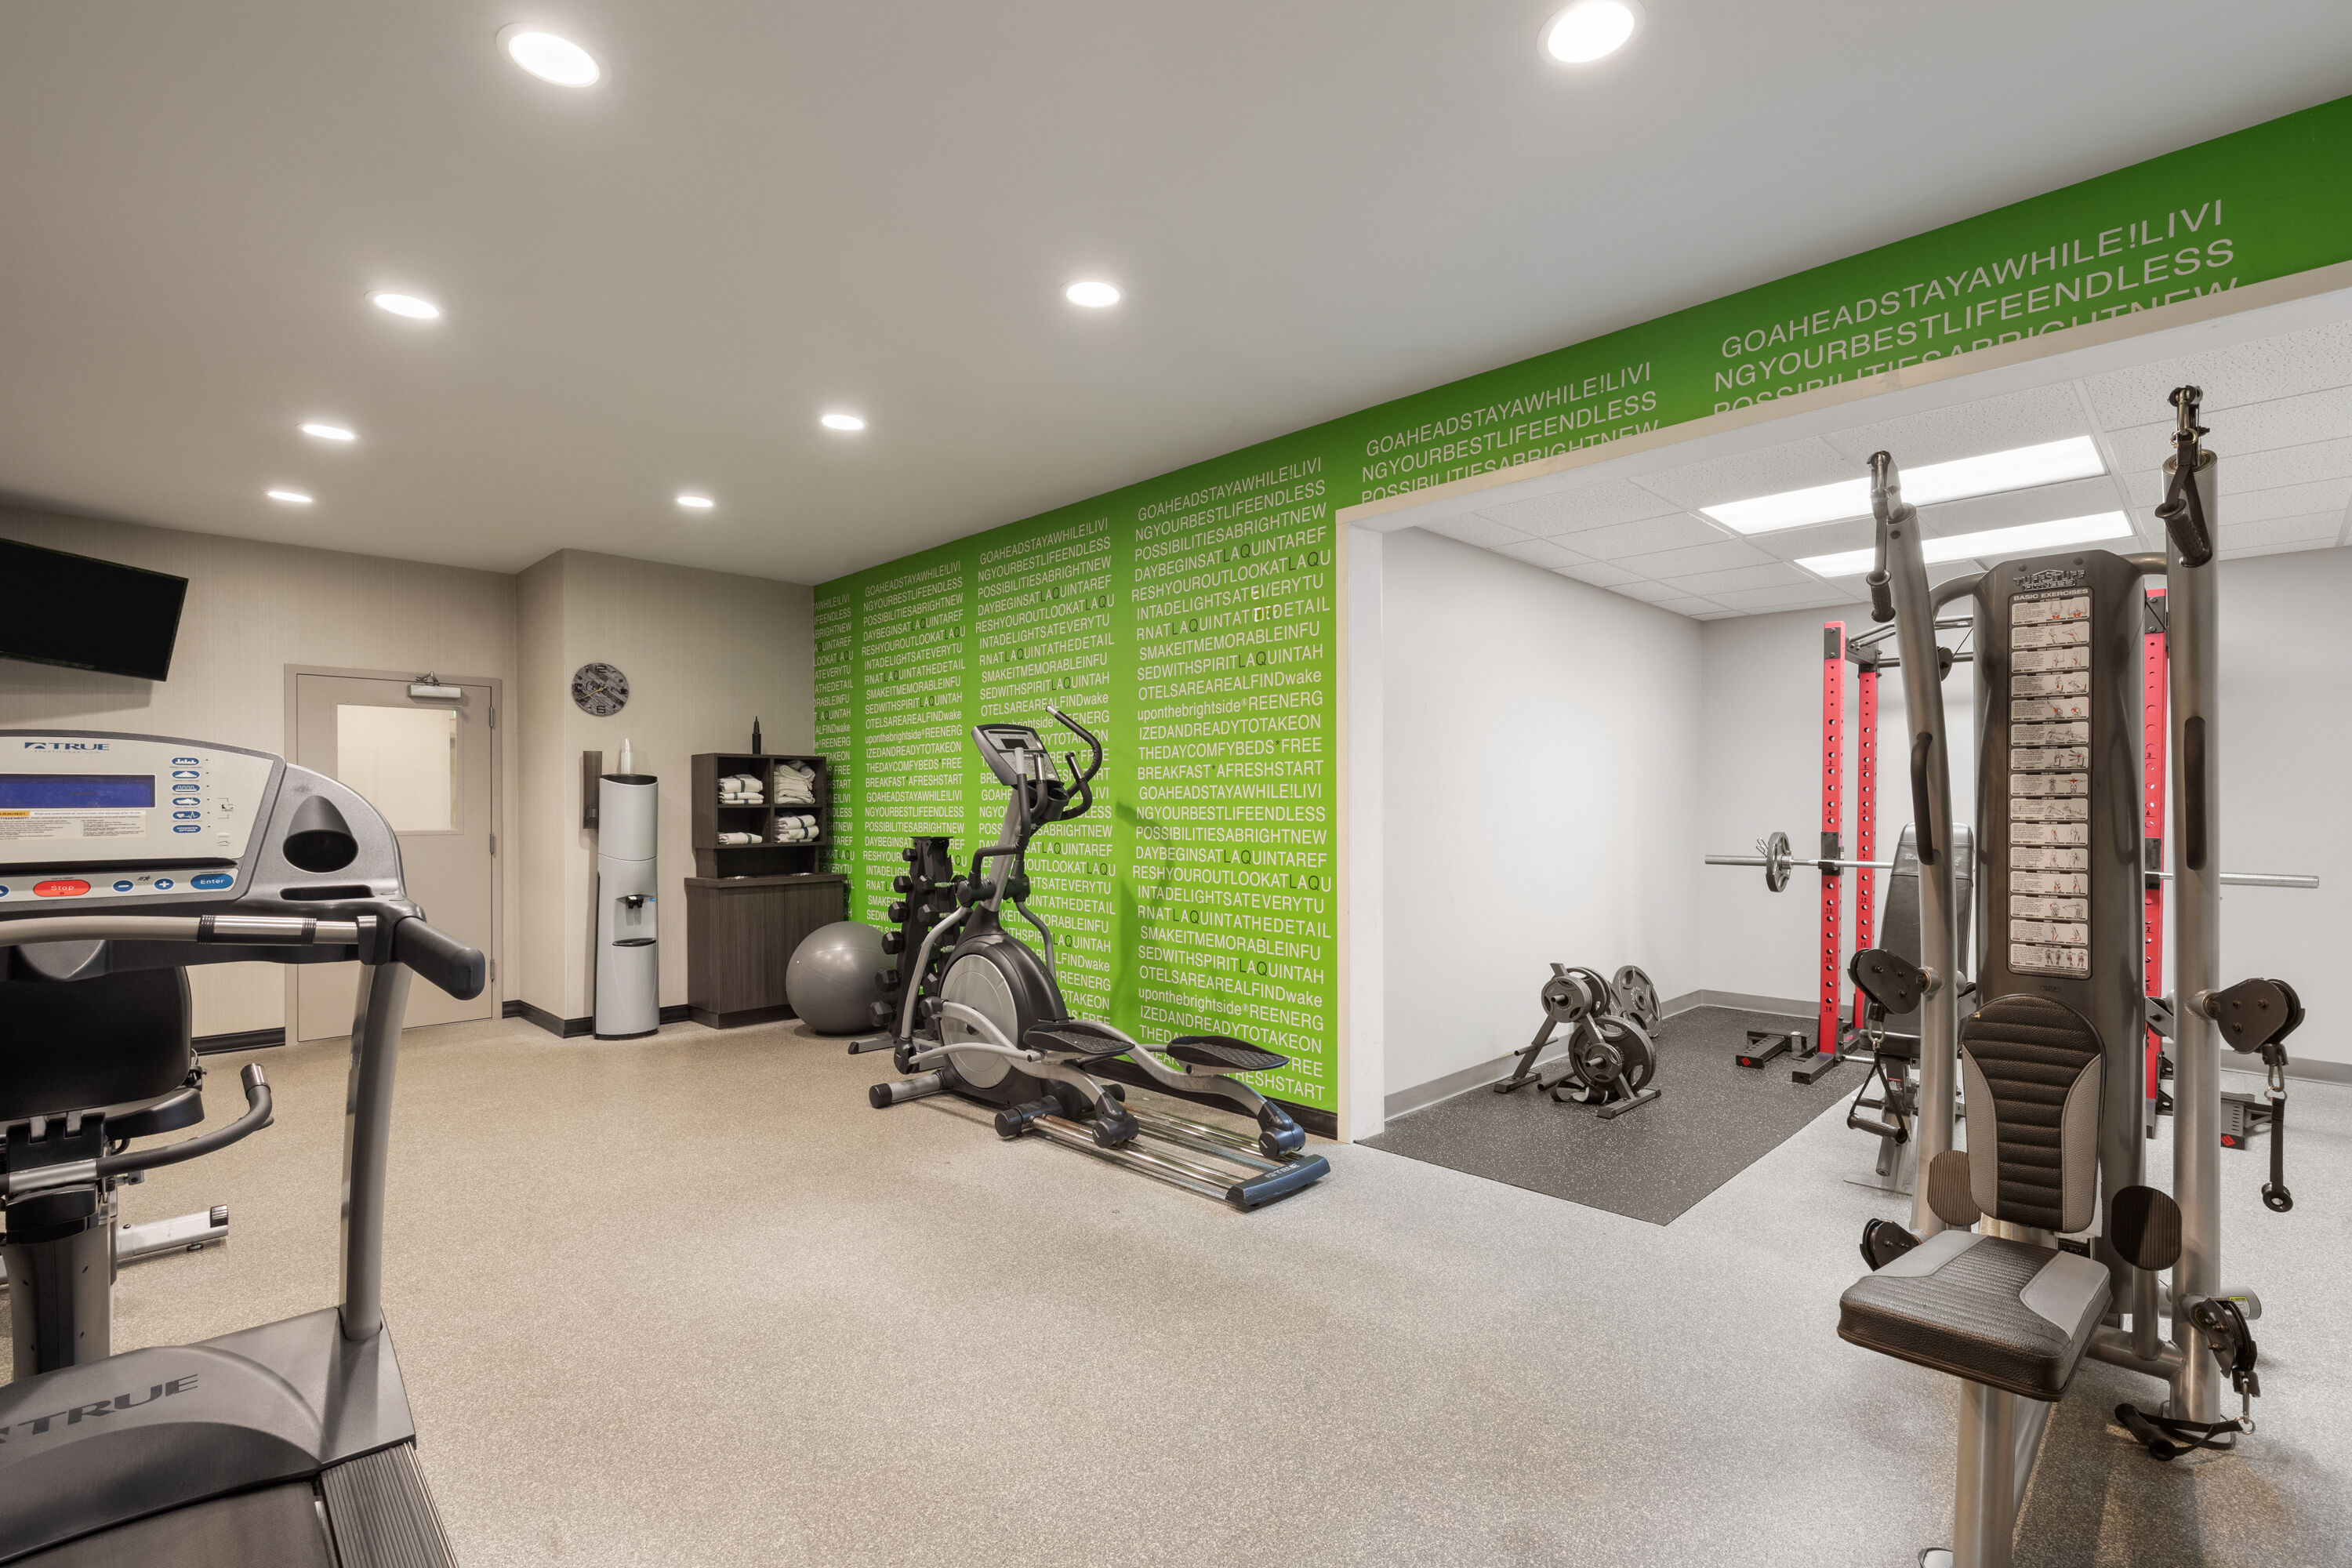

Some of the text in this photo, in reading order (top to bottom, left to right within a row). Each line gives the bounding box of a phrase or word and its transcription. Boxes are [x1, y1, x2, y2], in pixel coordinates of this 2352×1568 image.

[1722, 199, 2221, 358] GOAHEADSTAYAWHILE!LIVI
[1715, 239, 2233, 392] NGYOURBESTLIFEENDLESS
[1367, 362, 1650, 456] GOAHEADSTAYAWHILE!LIVI
[1363, 391, 1656, 483] NGYOURBESTLIFEENDLESS
[1138, 458, 1320, 521] GOAHEADSTAYAWHILE!LIVI
[1136, 479, 1325, 541] NGYOURBESTLIFEENDLESS
[1135, 503, 1326, 561] POSSIBILITIESABRIGHTNEW
[1135, 526, 1327, 582] DAYBEGINSATLAQUINTAREF
[1131, 550, 1330, 602] RESHYOUROUTLOOKATLAQU
[2013, 570, 2085, 586] TUFFSTUFF
[2041, 589, 2089, 597] EXERCISES
[1139, 621, 1319, 660] SMAKEITMEMORABLEINFU
[595, 665, 608, 673] 12
[1137, 644, 1323, 681] SEDWITHSPIRITLAQUINTAH
[1138, 670, 1322, 701] OTELSAREAREALFINDwake
[596, 705, 606, 713] 6
[1139, 714, 1320, 740] IZEDANDREADYTOTAKEON
[1139, 783, 1321, 800] GOAHEADSTAYAWHILE!LIVI
[1137, 806, 1325, 822] NGYOURBESTLIFEENDLESS
[1136, 826, 1327, 844] POSSIBILITIESABRIGHTNEW
[1136, 846, 1327, 868] DAYBEGINSATLAQUINTAREF
[1133, 866, 1330, 892] RESHYOUROUTLOOKATLAQU
[1138, 884, 1323, 914] INTADELIGHTSATEVERYTU
[1138, 905, 1330, 938] RNATLAQUINTATHEDETAIL
[1141, 926, 1320, 961] SMAKEITMEMORABLEINFU
[1138, 945, 1323, 984] SEDWITHSPIRITLAQUINTAH
[1139, 965, 1323, 1007] OTELSAREAREALFINDwake
[1141, 1005, 1322, 1054] IZEDANDREADYTOTAKEON
[17, 1374, 199, 1436] TRUE
